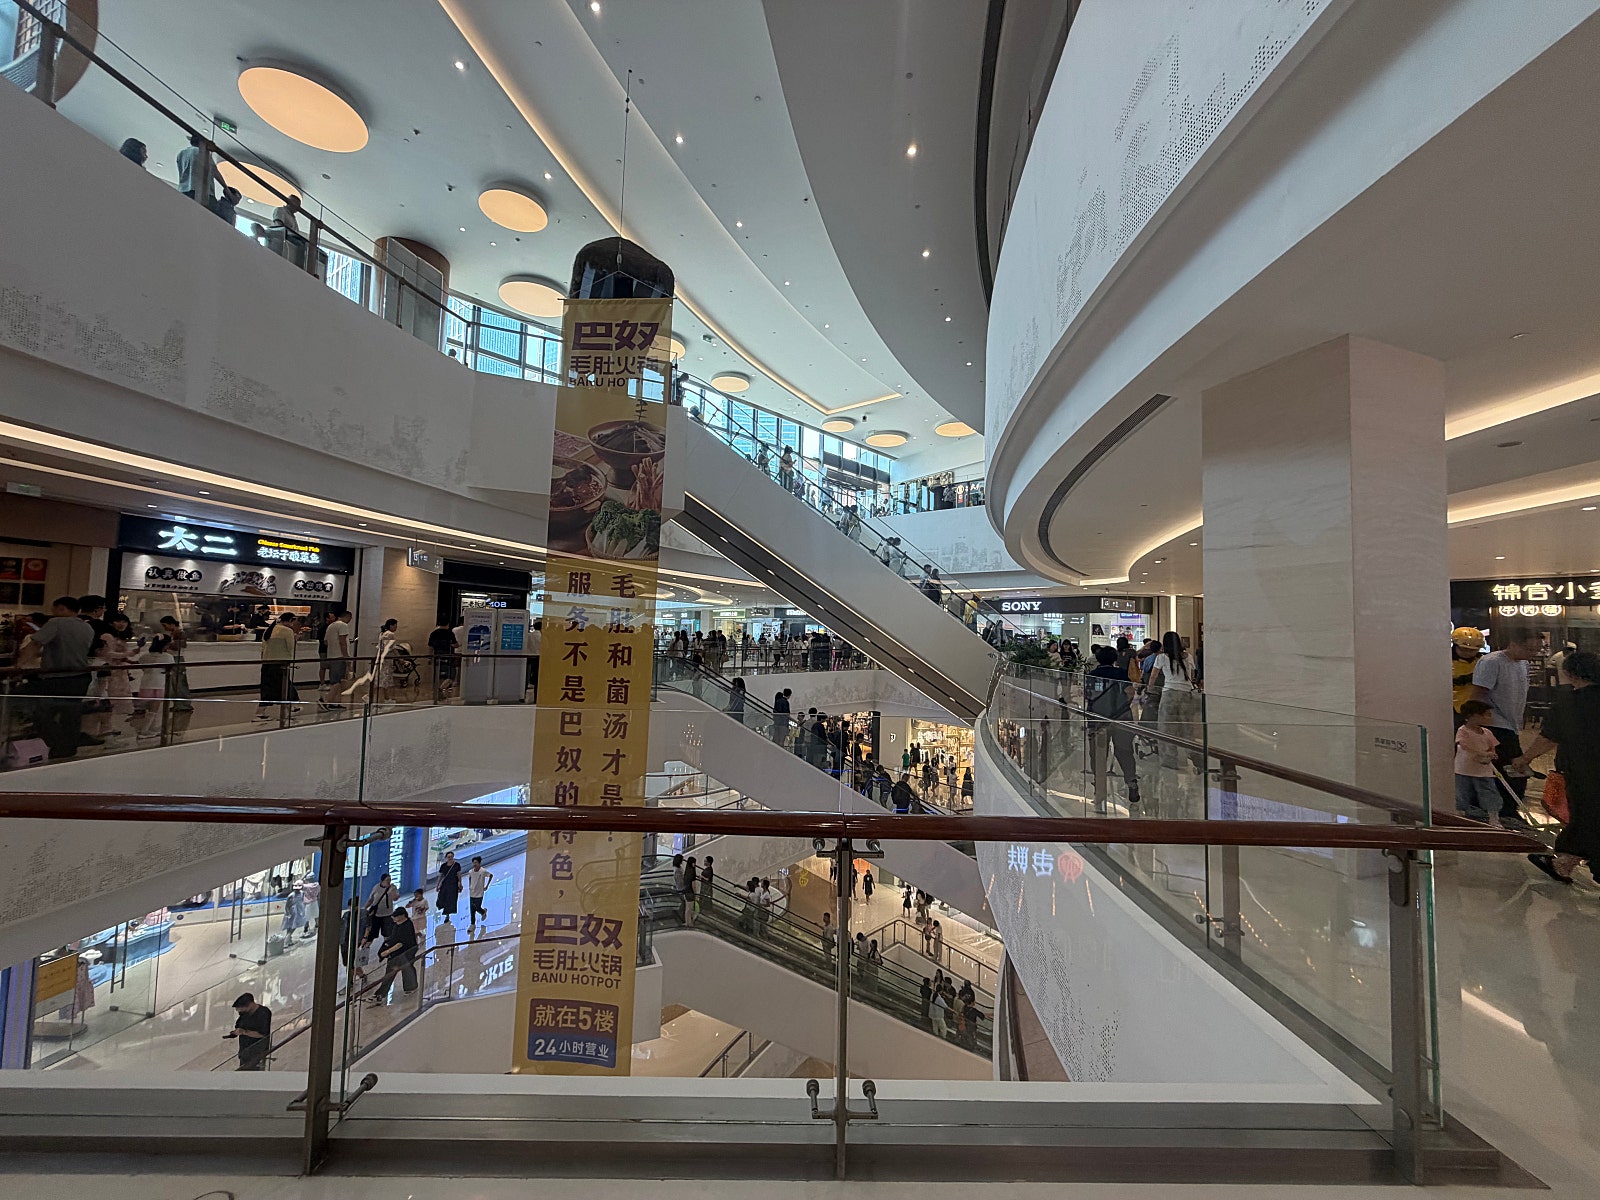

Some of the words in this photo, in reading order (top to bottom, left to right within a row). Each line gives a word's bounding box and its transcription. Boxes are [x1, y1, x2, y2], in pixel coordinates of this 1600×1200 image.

[572, 320, 660, 351] 巴奴
[157, 525, 238, 556] 太二
[147, 567, 201, 581] 认真做鱼
[1001, 601, 1042, 612] SONY
[535, 914, 624, 950] 巴奴
[533, 949, 623, 977] 毛肚火锅
[531, 972, 568, 984] BANU
[571, 974, 622, 990] HOTPOT
[533, 1004, 615, 1034] 就在5楼
